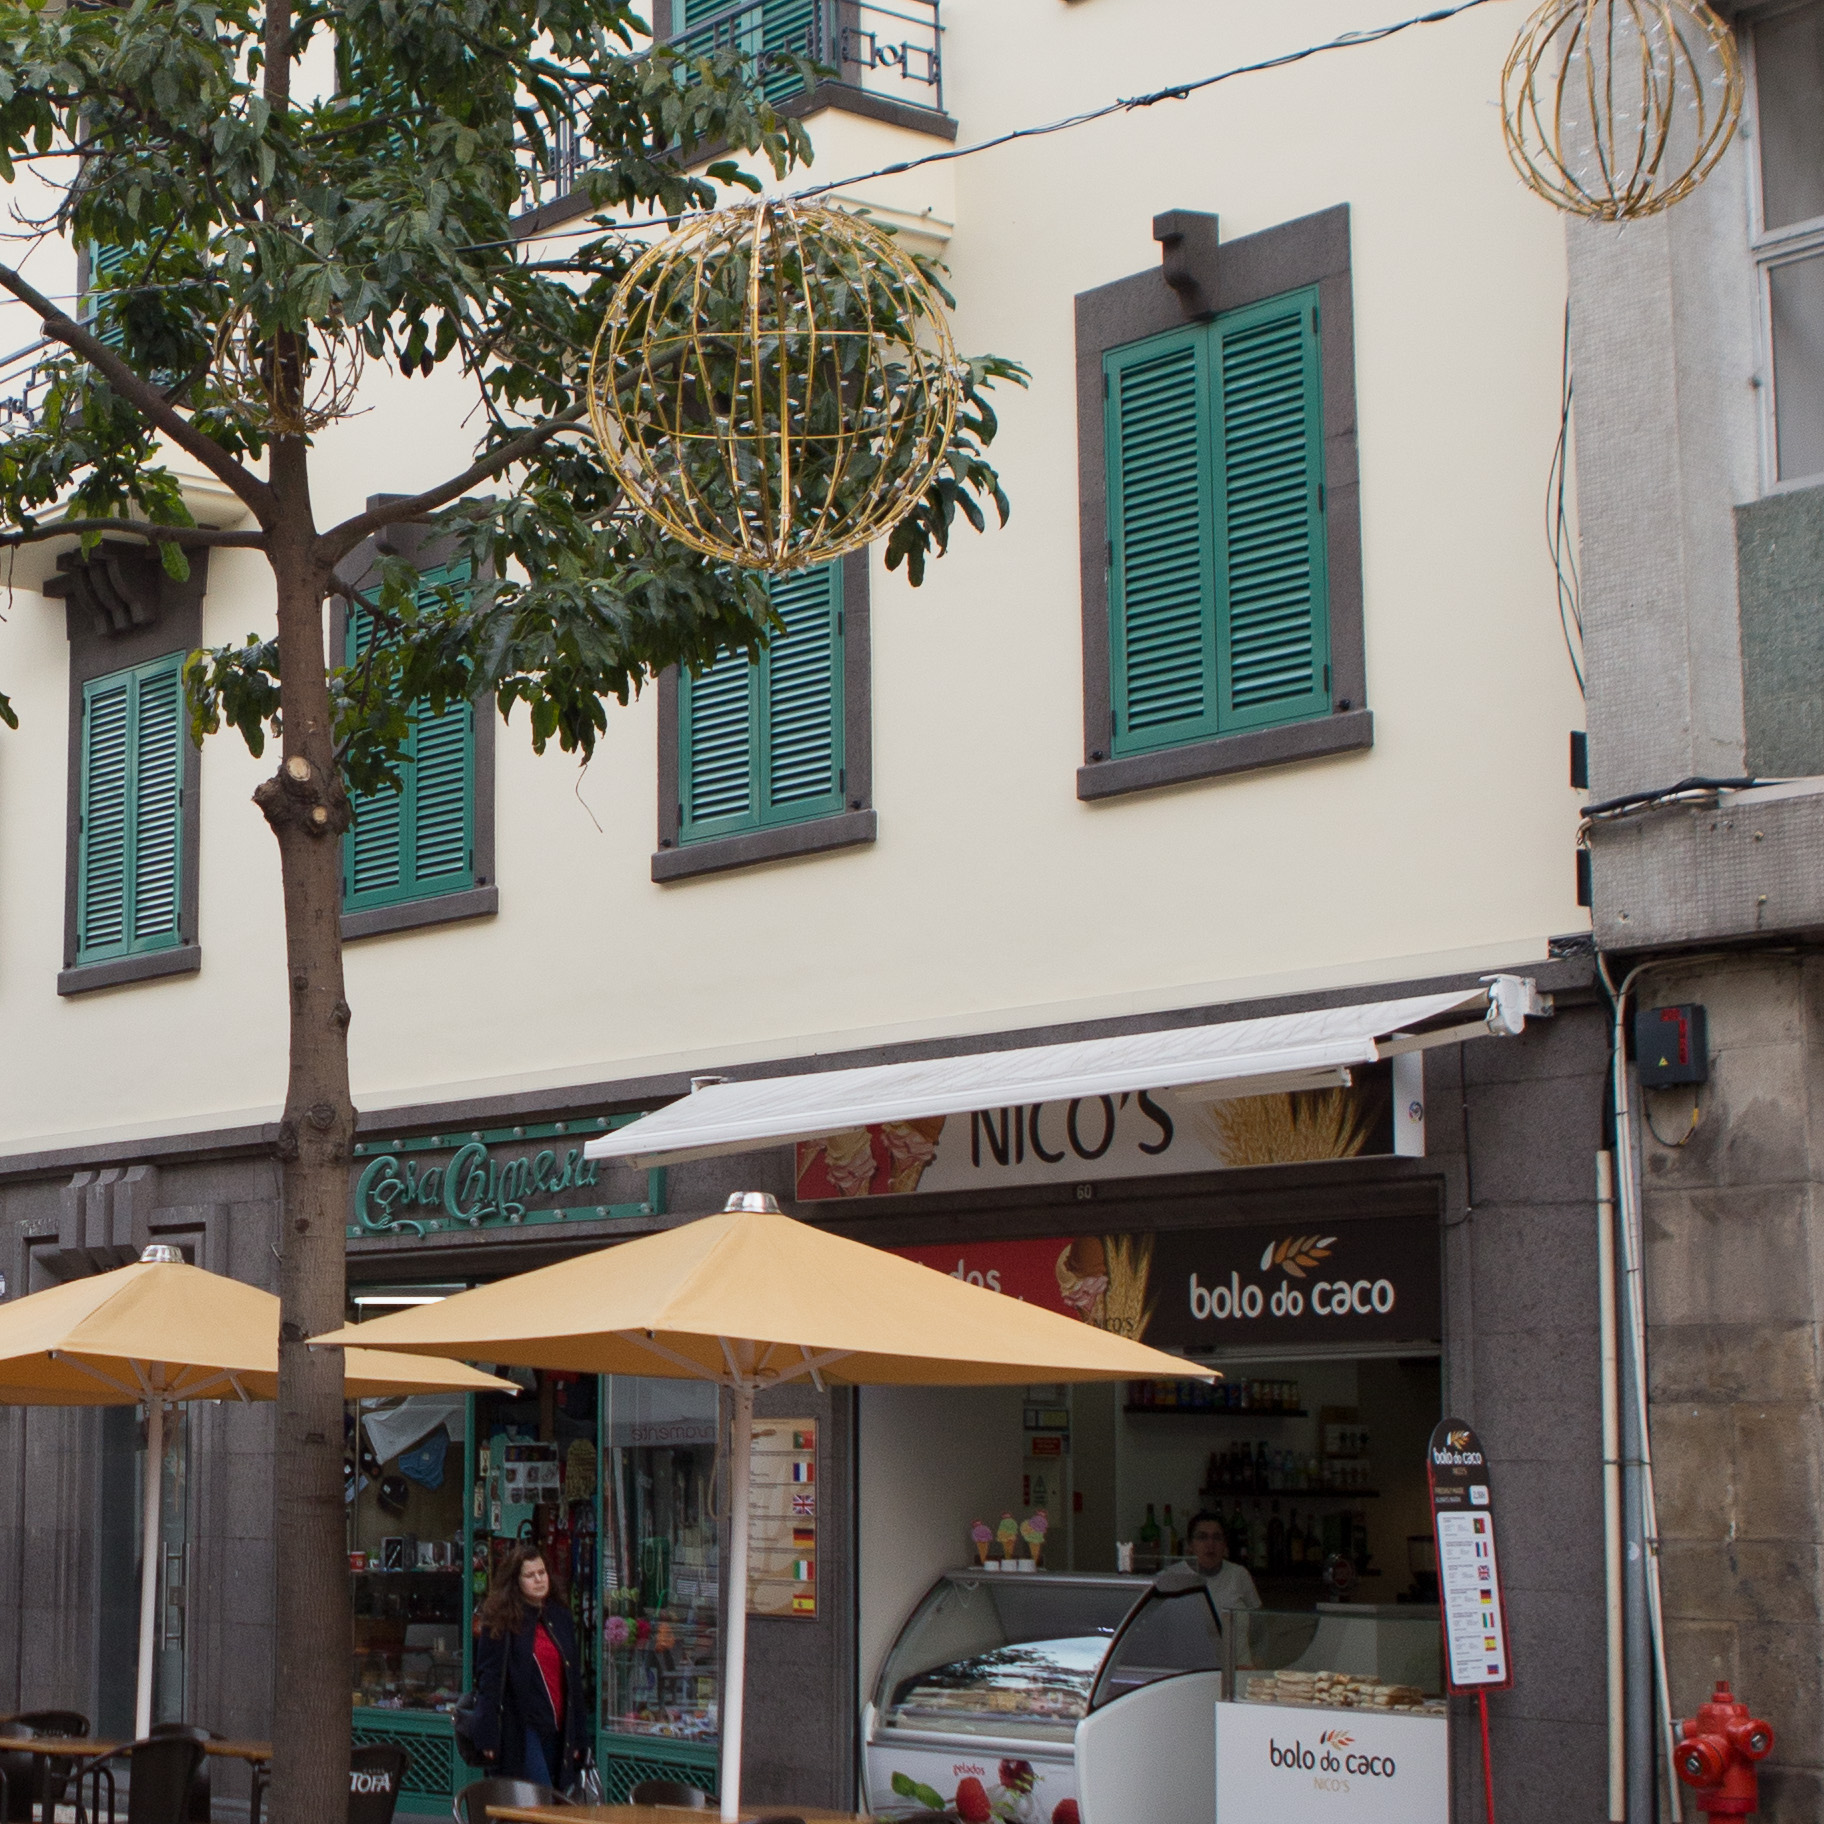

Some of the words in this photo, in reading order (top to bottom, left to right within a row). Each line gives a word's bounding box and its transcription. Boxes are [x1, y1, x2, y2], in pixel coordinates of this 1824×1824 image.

[971, 1087, 1174, 1168] NICO'S
[1076, 1183, 1092, 1200] 60
[1189, 1270, 1264, 1320] bolo
[1270, 1279, 1304, 1317] do
[1311, 1278, 1395, 1316] caco
[1432, 1447, 1453, 1465] bolo
[1453, 1451, 1462, 1464] do
[1462, 1452, 1483, 1465] caco
[1269, 1738, 1315, 1770] bolo
[1320, 1750, 1340, 1772] do
[1345, 1754, 1396, 1778] caco
[952, 1763, 986, 1776] gelados
[1314, 1777, 1351, 1793] NICO'S
